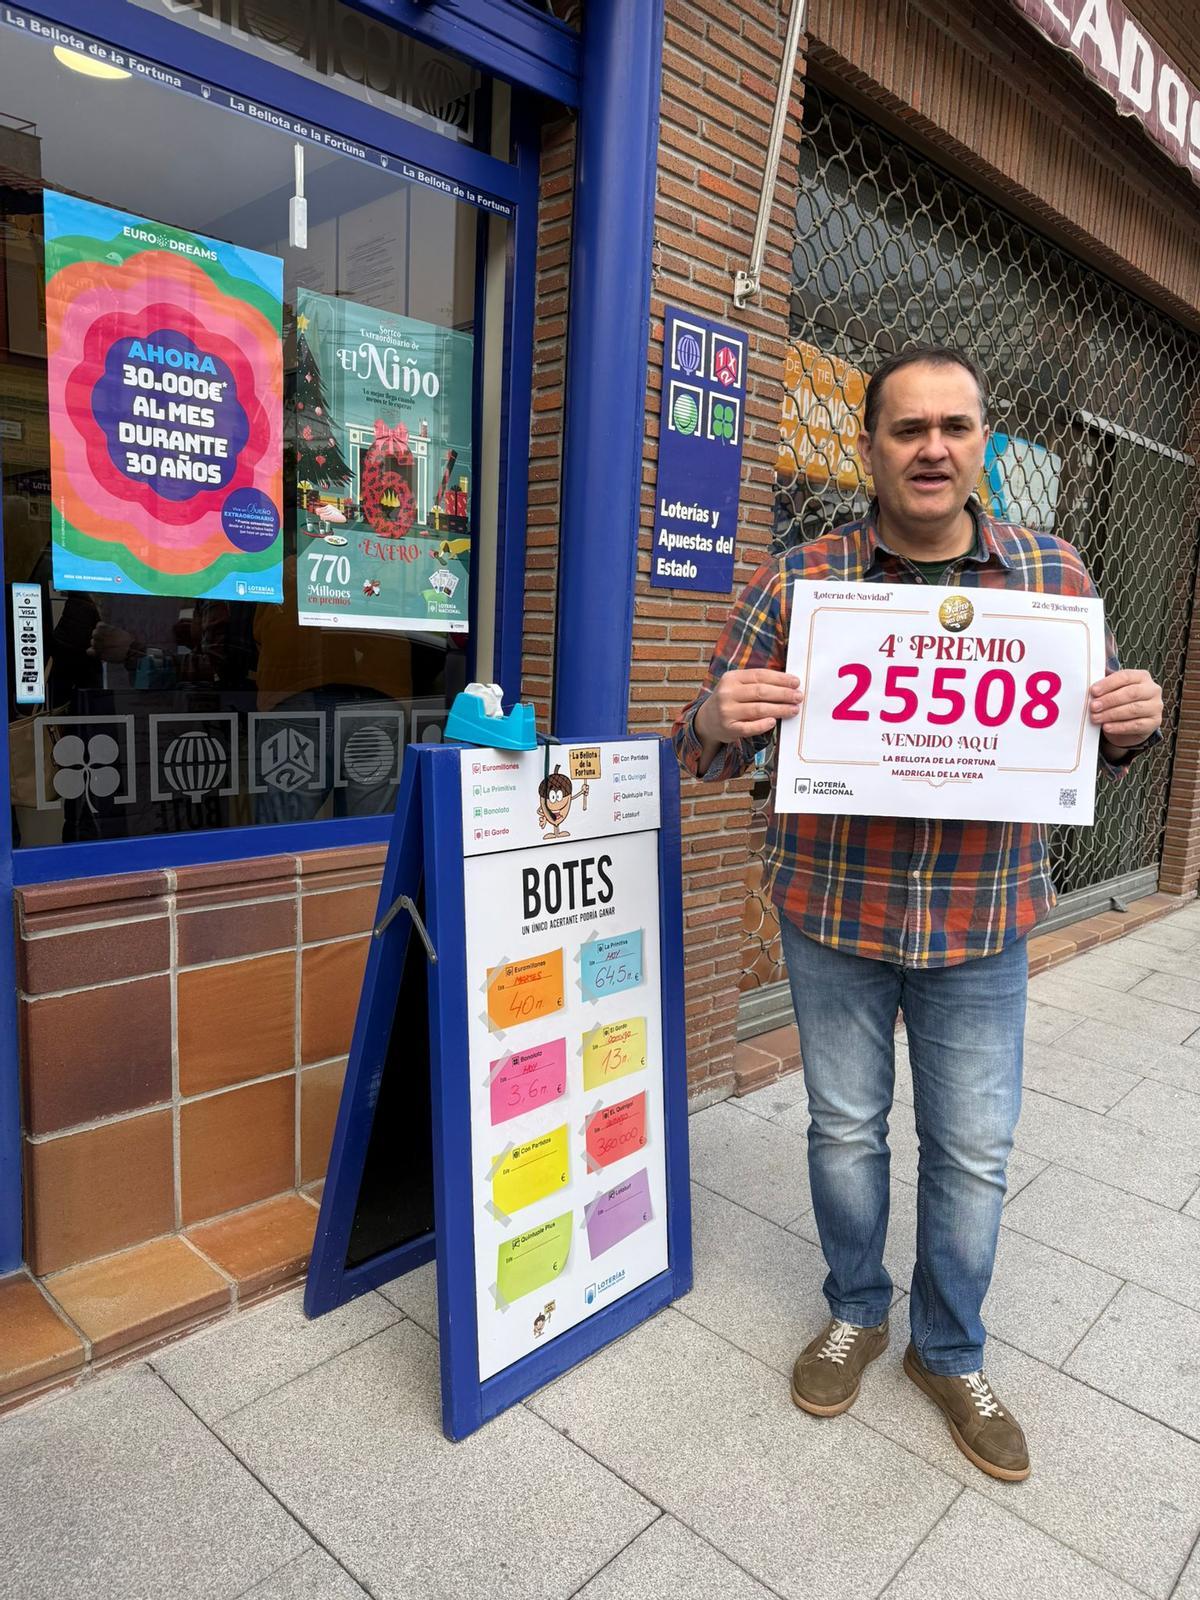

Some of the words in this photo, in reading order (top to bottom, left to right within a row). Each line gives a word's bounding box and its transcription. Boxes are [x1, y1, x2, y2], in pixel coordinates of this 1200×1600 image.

[6, 10, 25, 28] La
[30, 19, 85, 49] Bellota
[89, 44, 107, 58] de
[111, 50, 125, 65] la
[128, 57, 182, 88] Fortuna
[229, 97, 245, 112] La
[248, 104, 290, 129] Bellota
[293, 123, 308, 136] de
[311, 129, 321, 141] la
[324, 134, 366, 158] Fortuna
[402, 165, 415, 178] La
[417, 171, 451, 192] Bellota
[453, 186, 465, 197] de
[467, 190, 475, 201] la
[477, 194, 511, 215] Fortuna
[169, 240, 218, 261] DREAMS
[360, 328, 410, 348] Extraordinario
[128, 341, 218, 376] AHORA
[336, 348, 357, 371] El
[358, 343, 439, 397] Niño
[133, 396, 165, 420] AL
[168, 402, 215, 429] MES
[118, 421, 228, 458] DURANTE
[126, 451, 156, 475] 30
[160, 454, 222, 484] AÑOS
[661, 499, 709, 523] Loterías
[711, 511, 720, 529] y
[658, 528, 713, 552] Apuestas
[716, 535, 734, 554] del
[307, 553, 351, 585] 770
[656, 557, 698, 579] Estado
[307, 583, 351, 598] Millones
[845, 592, 856, 600] de
[320, 597, 351, 606] premios
[1032, 601, 1041, 609] 22
[1041, 601, 1050, 609] de
[878, 634, 904, 658] 4º
[909, 635, 1026, 663] PREMIO
[832, 663, 1062, 729] 25508
[881, 733, 953, 749] VENDIDO
[957, 733, 998, 752] AQUÍ
[579, 751, 598, 759] Bellota
[895, 755, 931, 764] BELLOTA
[945, 757, 955, 765] LA
[957, 758, 996, 766] FORTUNA
[482, 763, 520, 772] Euromillones
[891, 769, 936, 777] MADRIGAL
[937, 770, 948, 778] DE
[962, 771, 984, 779] VERA
[483, 786, 491, 794] La
[491, 785, 517, 793] Primitiva
[812, 788, 854, 796] NACIONAL
[813, 780, 846, 788] LOTERÍA
[484, 807, 510, 815] Bonoloto
[491, 828, 510, 836] Gordo
[522, 854, 614, 920] BOTES
[521, 925, 530, 935] UN
[531, 921, 548, 933] ÚNICO
[549, 914, 578, 929] ACERTANTE
[579, 909, 598, 922] PODRÍA
[598, 906, 616, 918] GANAR
[514, 960, 546, 973] Euromillones
[520, 1051, 543, 1062] Bonoloto
[520, 1146, 532, 1154] Con
[532, 1138, 552, 1150] Partidos
[597, 1269, 626, 1290] LOTERÍAS
